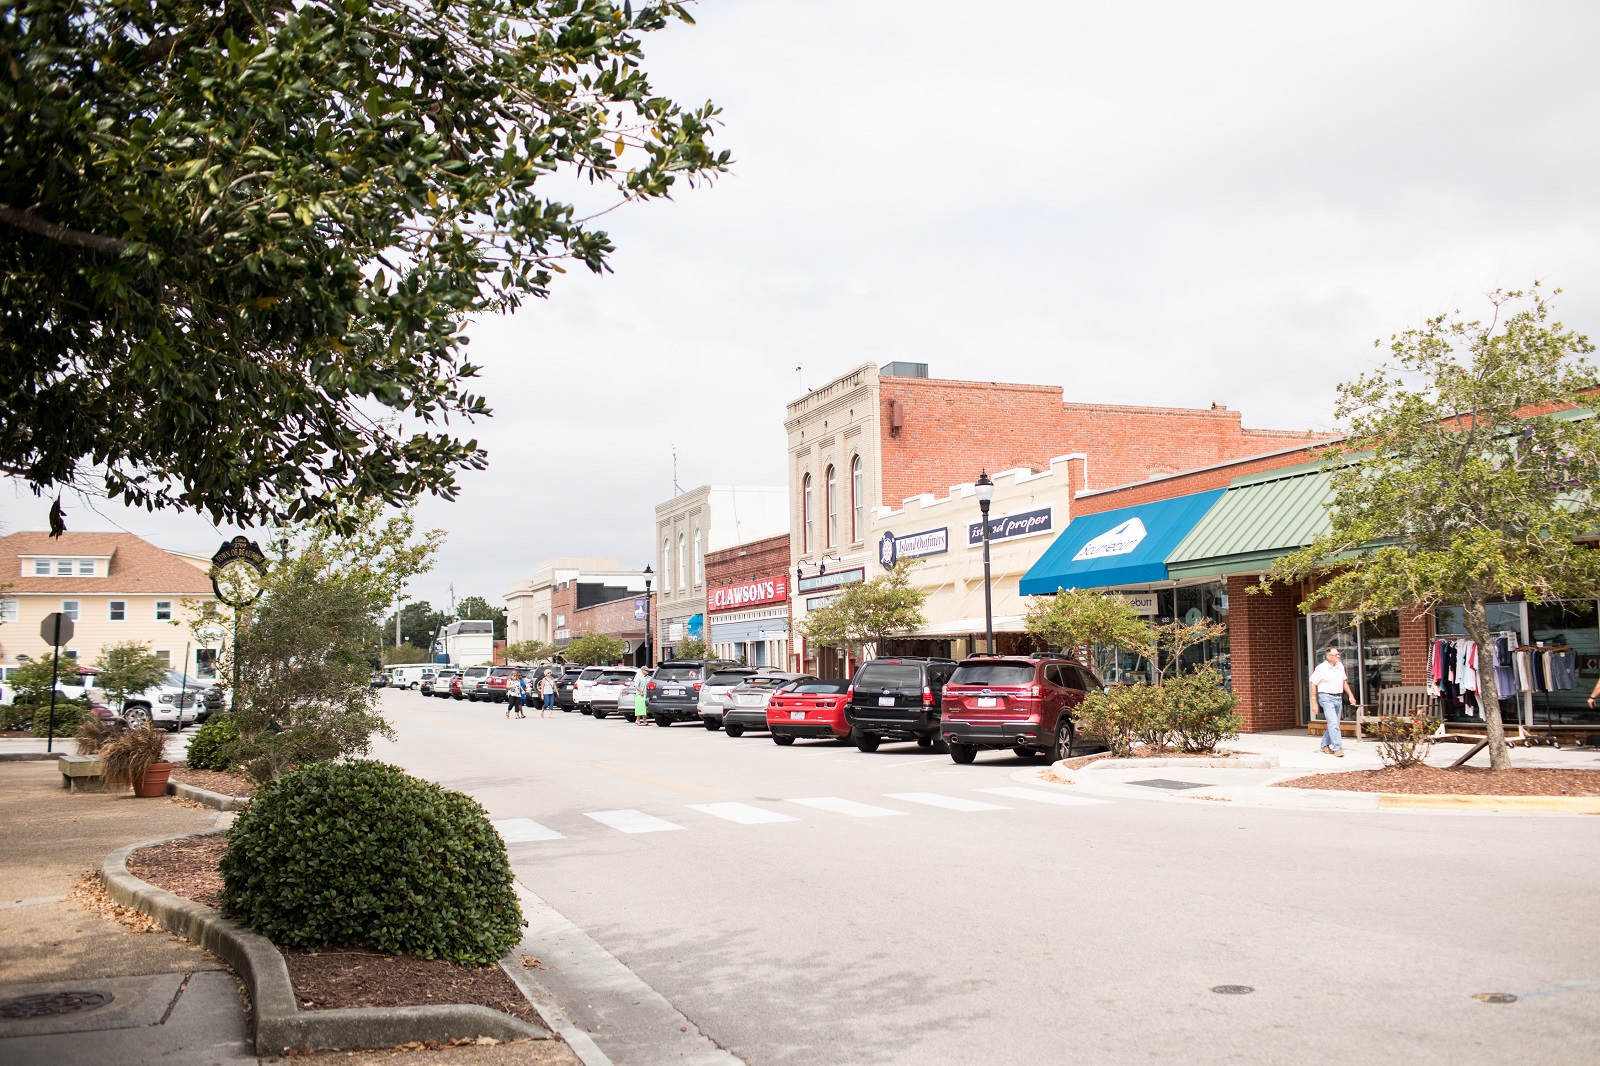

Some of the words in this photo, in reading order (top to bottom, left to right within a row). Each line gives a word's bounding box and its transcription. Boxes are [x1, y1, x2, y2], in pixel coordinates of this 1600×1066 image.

[971, 517, 1008, 538] islnd
[1005, 515, 1049, 536] proper
[898, 537, 917, 553] Island
[916, 534, 945, 551] Outfitters
[215, 550, 231, 563] TOWN
[230, 548, 238, 557] OF
[815, 574, 844, 587] CLAWSON'S
[715, 581, 775, 607] CLAWSON'S
